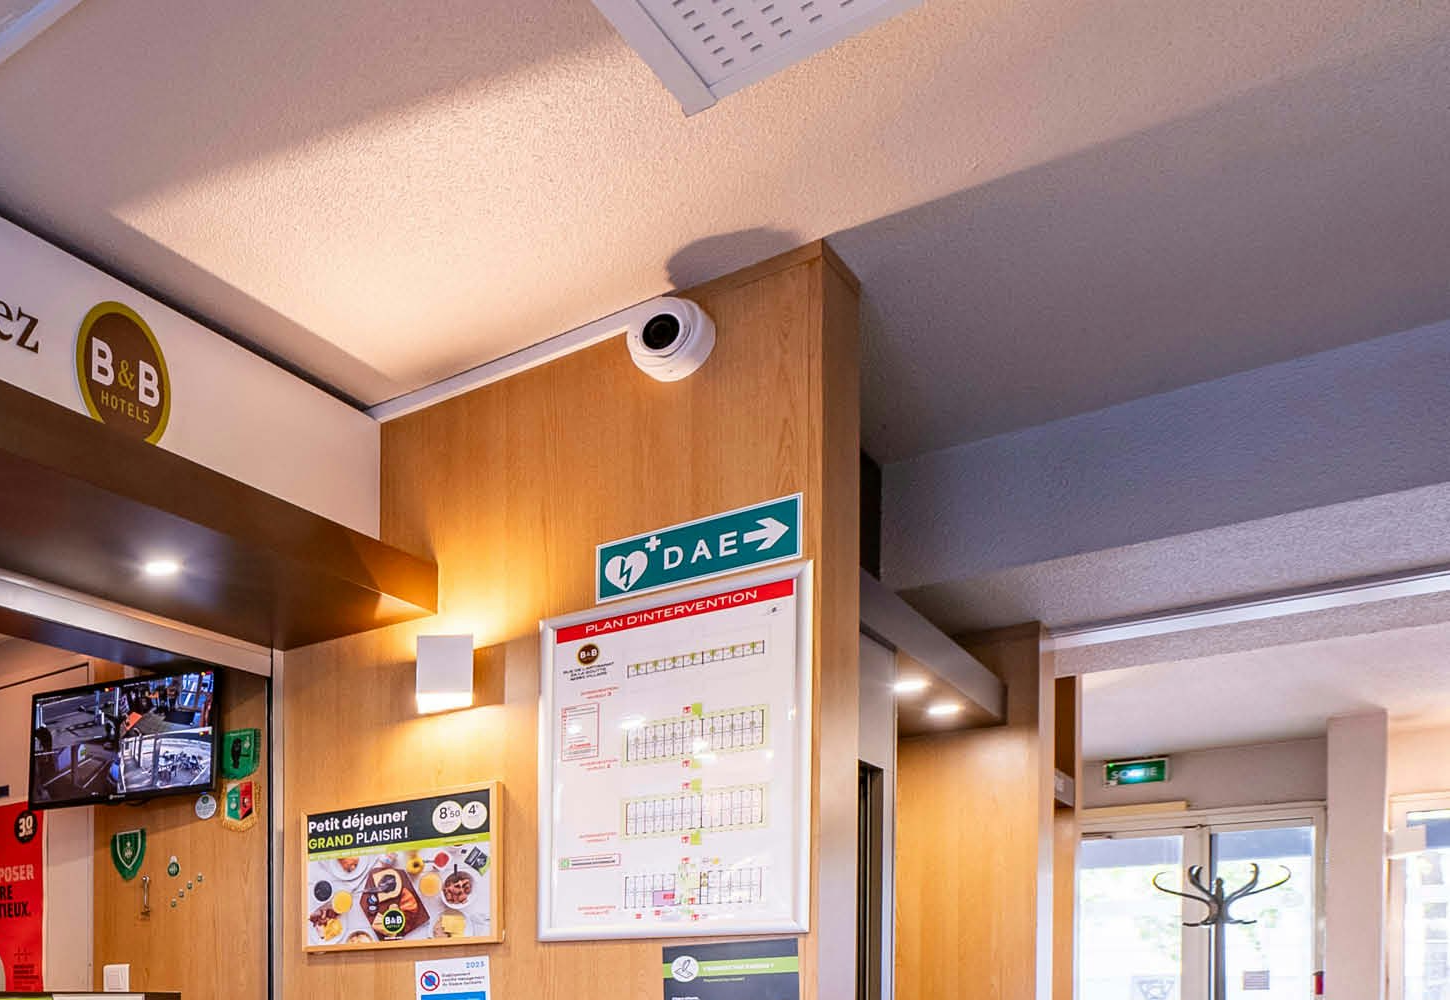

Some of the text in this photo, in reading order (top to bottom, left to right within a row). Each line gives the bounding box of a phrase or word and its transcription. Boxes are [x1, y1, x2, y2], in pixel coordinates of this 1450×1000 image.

[91, 335, 160, 408] B&B
[101, 389, 150, 424] HOTELS
[663, 530, 739, 570] DAE
[585, 590, 758, 635] PLAN D'INTERVENTION
[1110, 766, 1158, 780] SOIE
[18, 815, 34, 838] 30
[308, 809, 408, 834] Petit déjeuner
[308, 826, 409, 850] GRAND PLAISIR !
[384, 916, 403, 925] B&B
